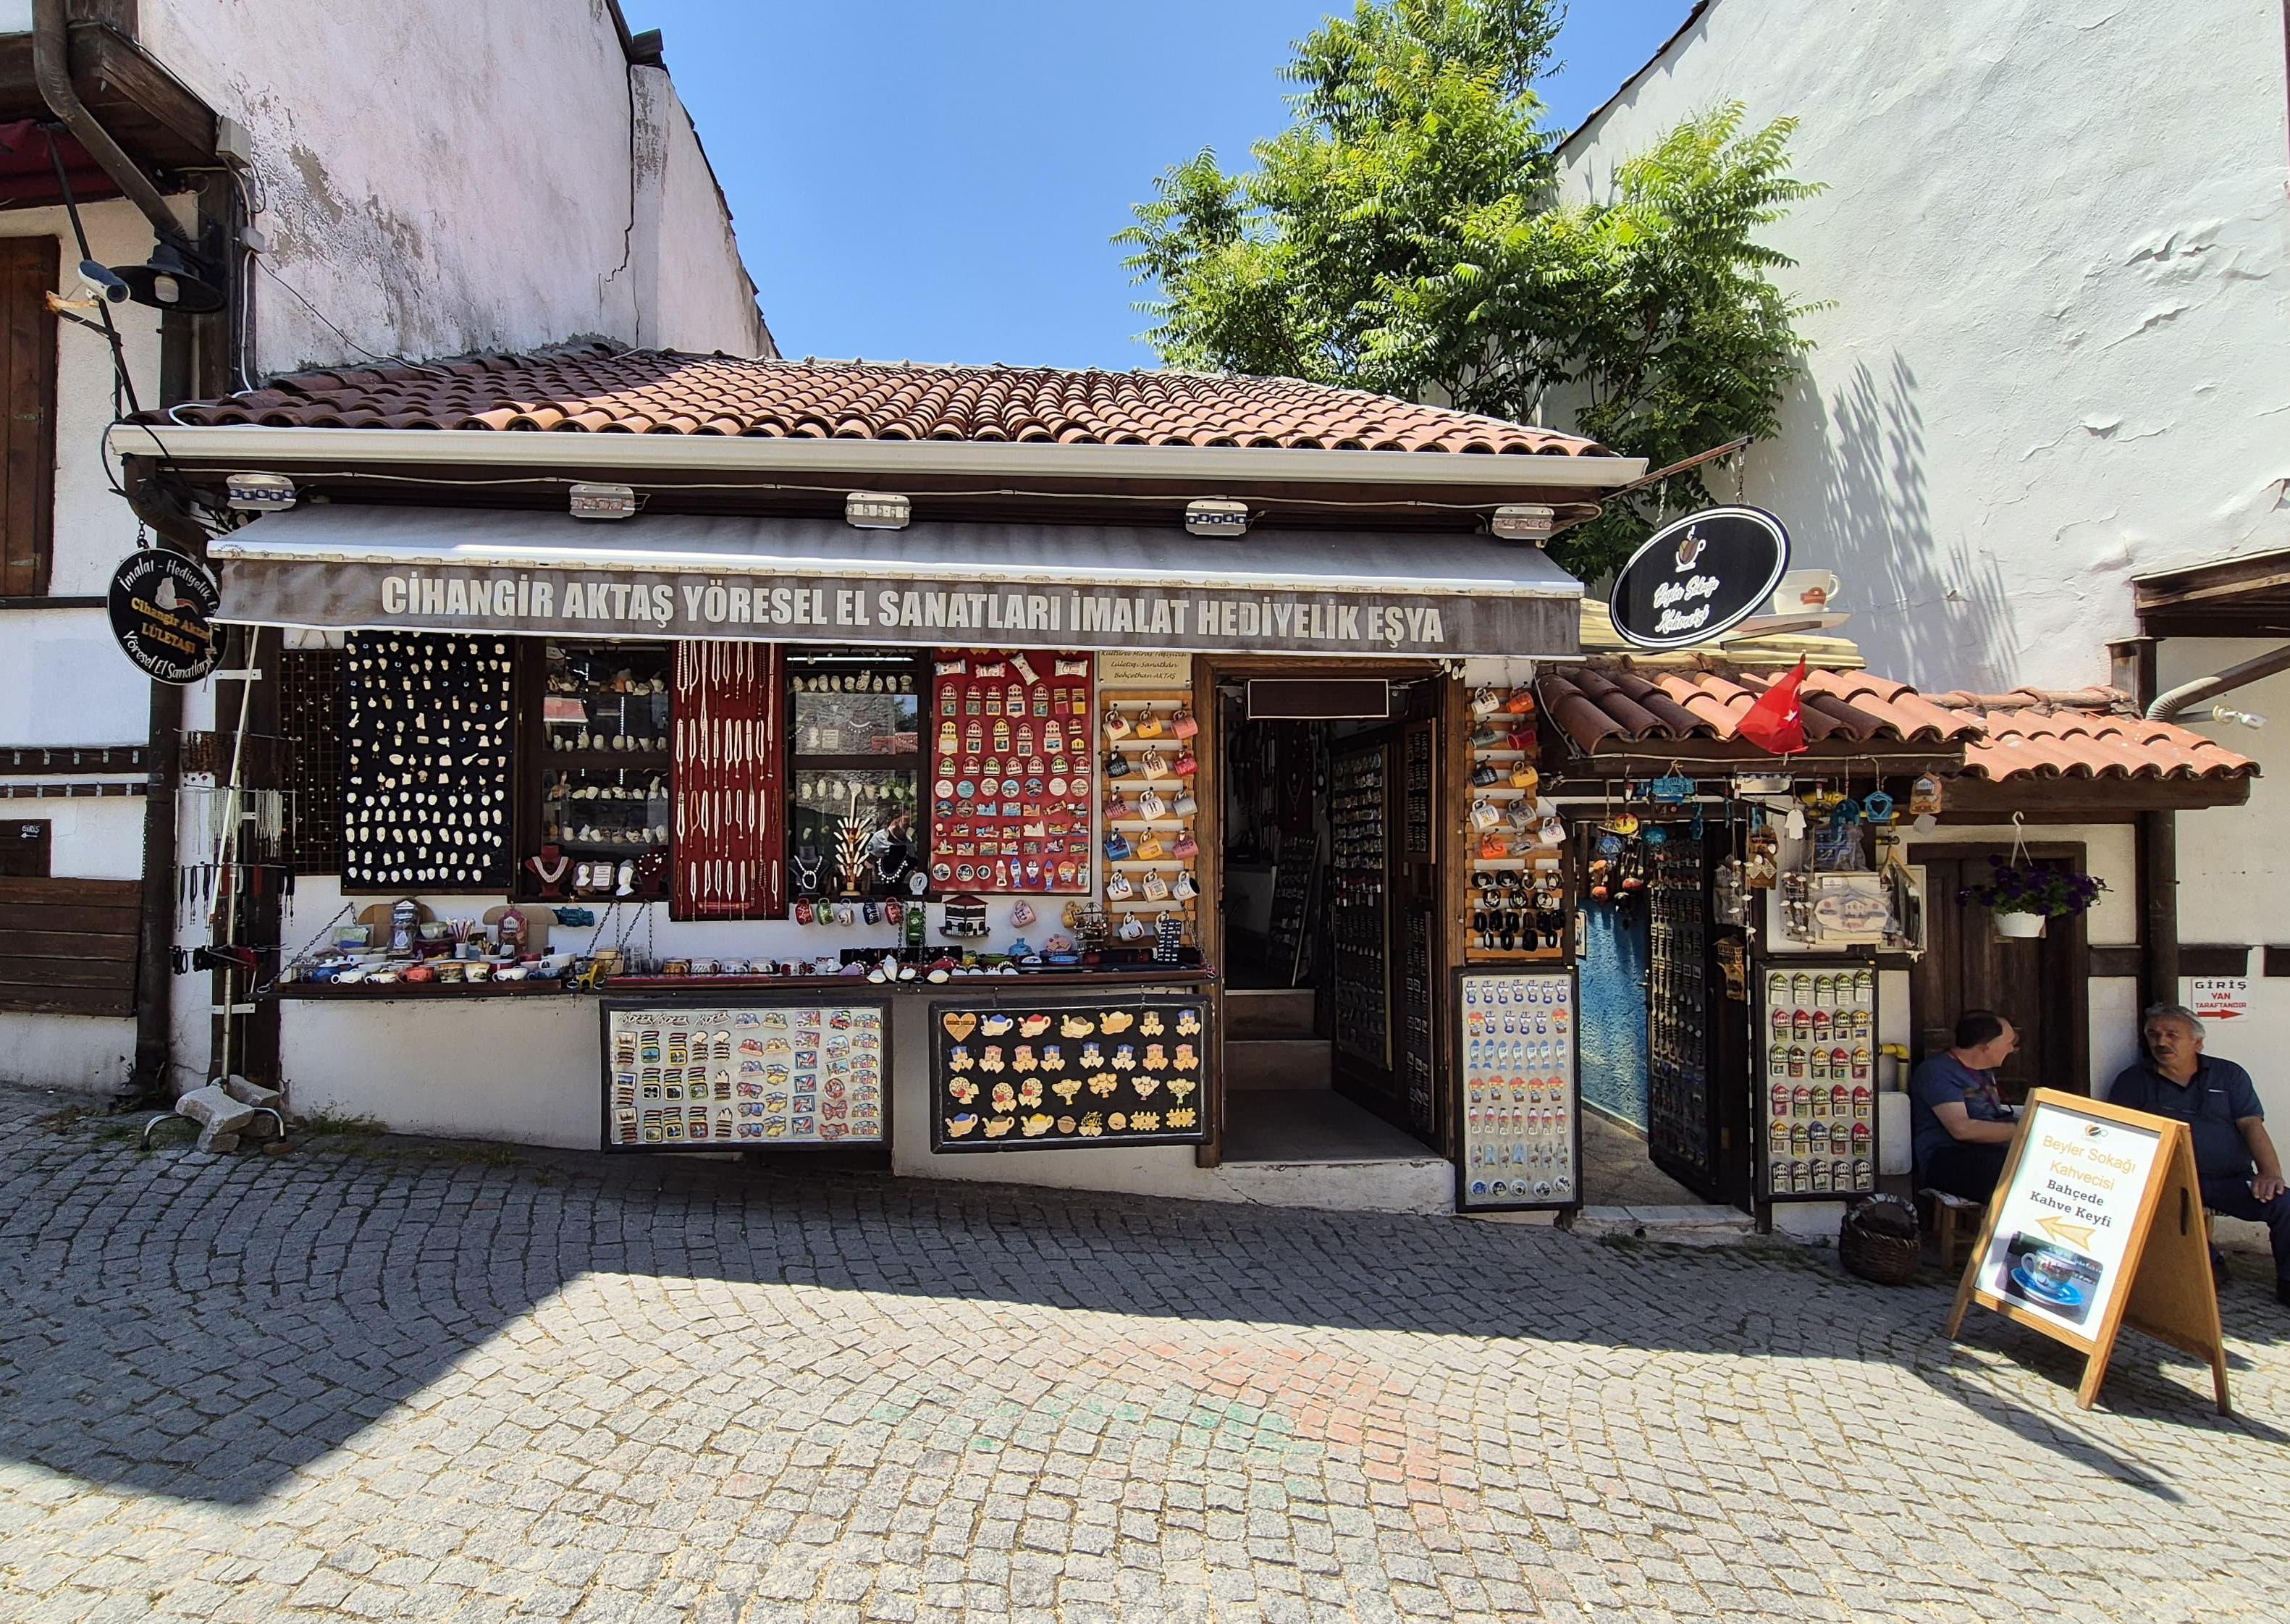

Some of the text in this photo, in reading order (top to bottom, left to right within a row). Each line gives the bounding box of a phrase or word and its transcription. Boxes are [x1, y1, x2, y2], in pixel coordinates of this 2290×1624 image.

[117, 557, 155, 592] İmalat
[166, 559, 211, 601] Hediyelik
[130, 597, 180, 627] Cihangir
[381, 571, 1444, 649] CİHANGİR AKTAŞ YÖRESEL EL SANATLARI İMALAT HEDİYELİK EŞYA
[123, 630, 157, 669] Yöresel
[154, 659, 167, 676] El
[2194, 980, 2247, 990] GİRİŞ
[2042, 1135, 2137, 1174] Beyler Sokağı
[2046, 1179, 2105, 1207] Bahçede
[2050, 1161, 2116, 1191] Kahvecisi
[2029, 1191, 2113, 1229] Kahve Keyfi
